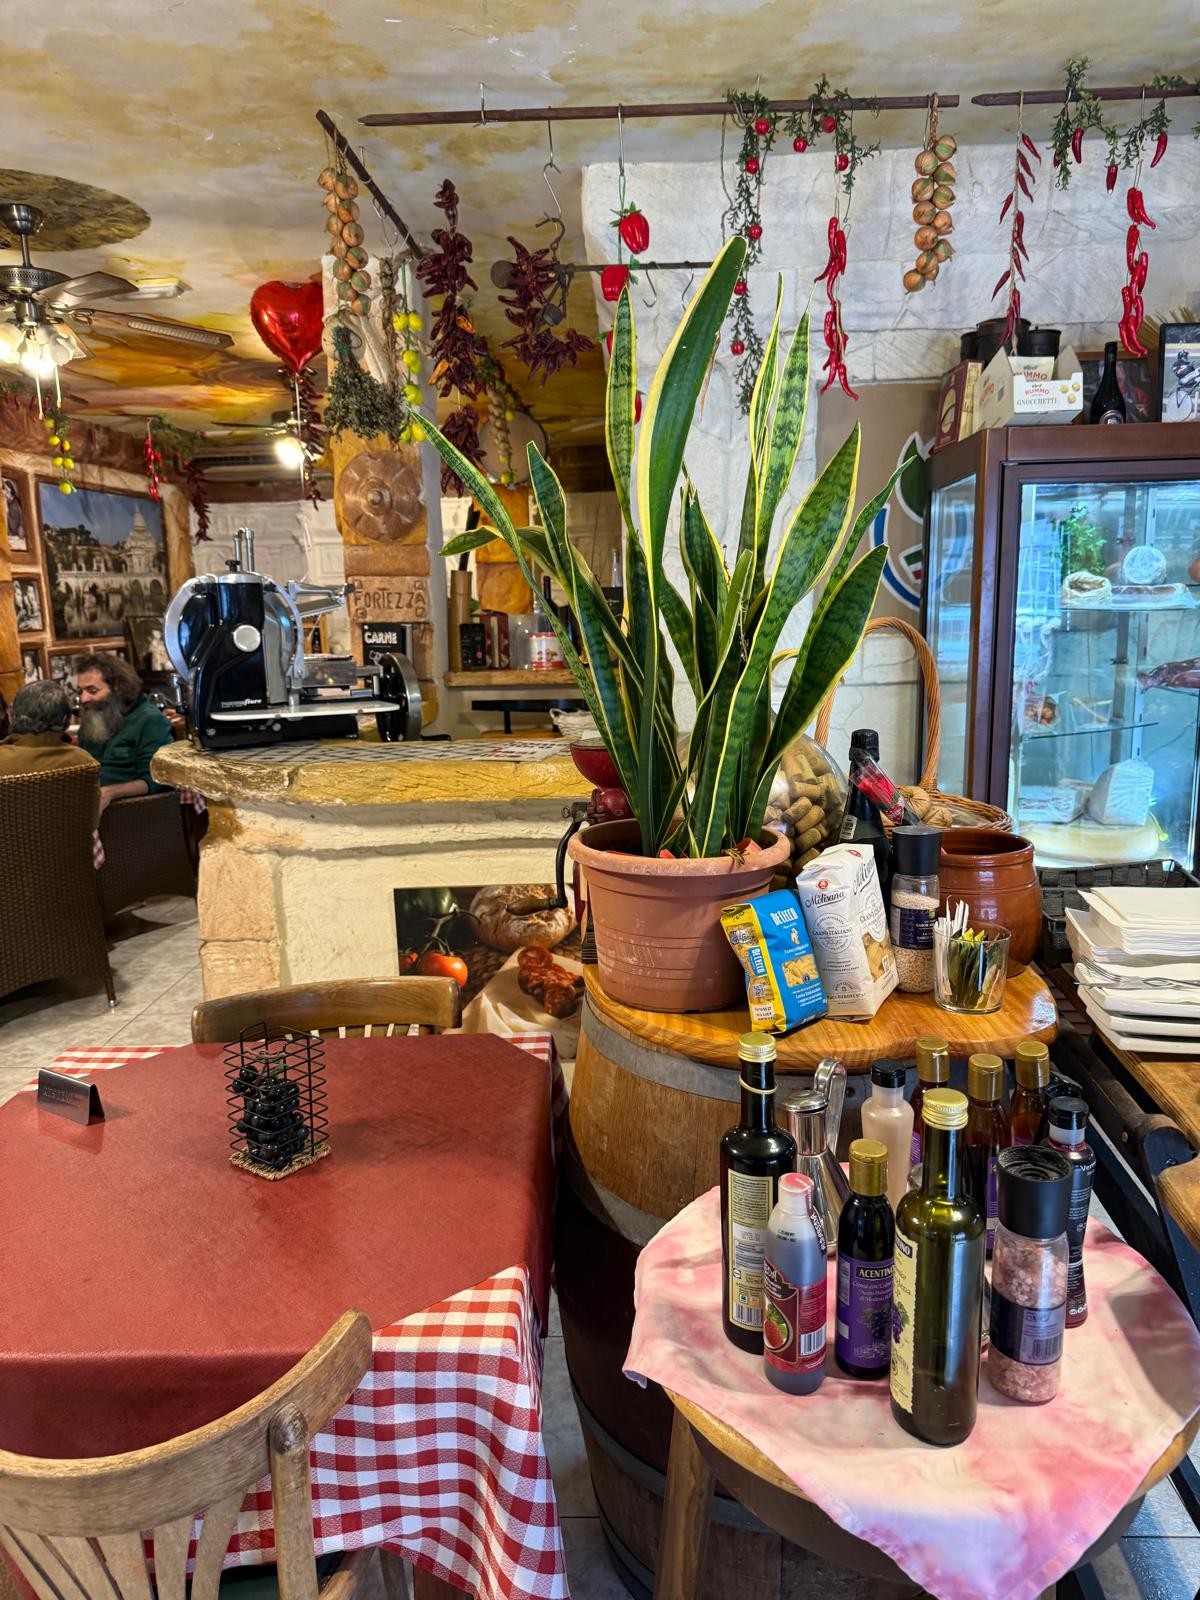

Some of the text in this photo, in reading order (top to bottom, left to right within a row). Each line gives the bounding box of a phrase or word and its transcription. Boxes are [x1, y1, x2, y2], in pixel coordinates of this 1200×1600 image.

[1013, 369, 1048, 380] UMMO
[1017, 397, 1057, 406] GNOCCHETTI
[354, 587, 426, 611] FORTEZZA
[364, 631, 398, 644] CARNE
